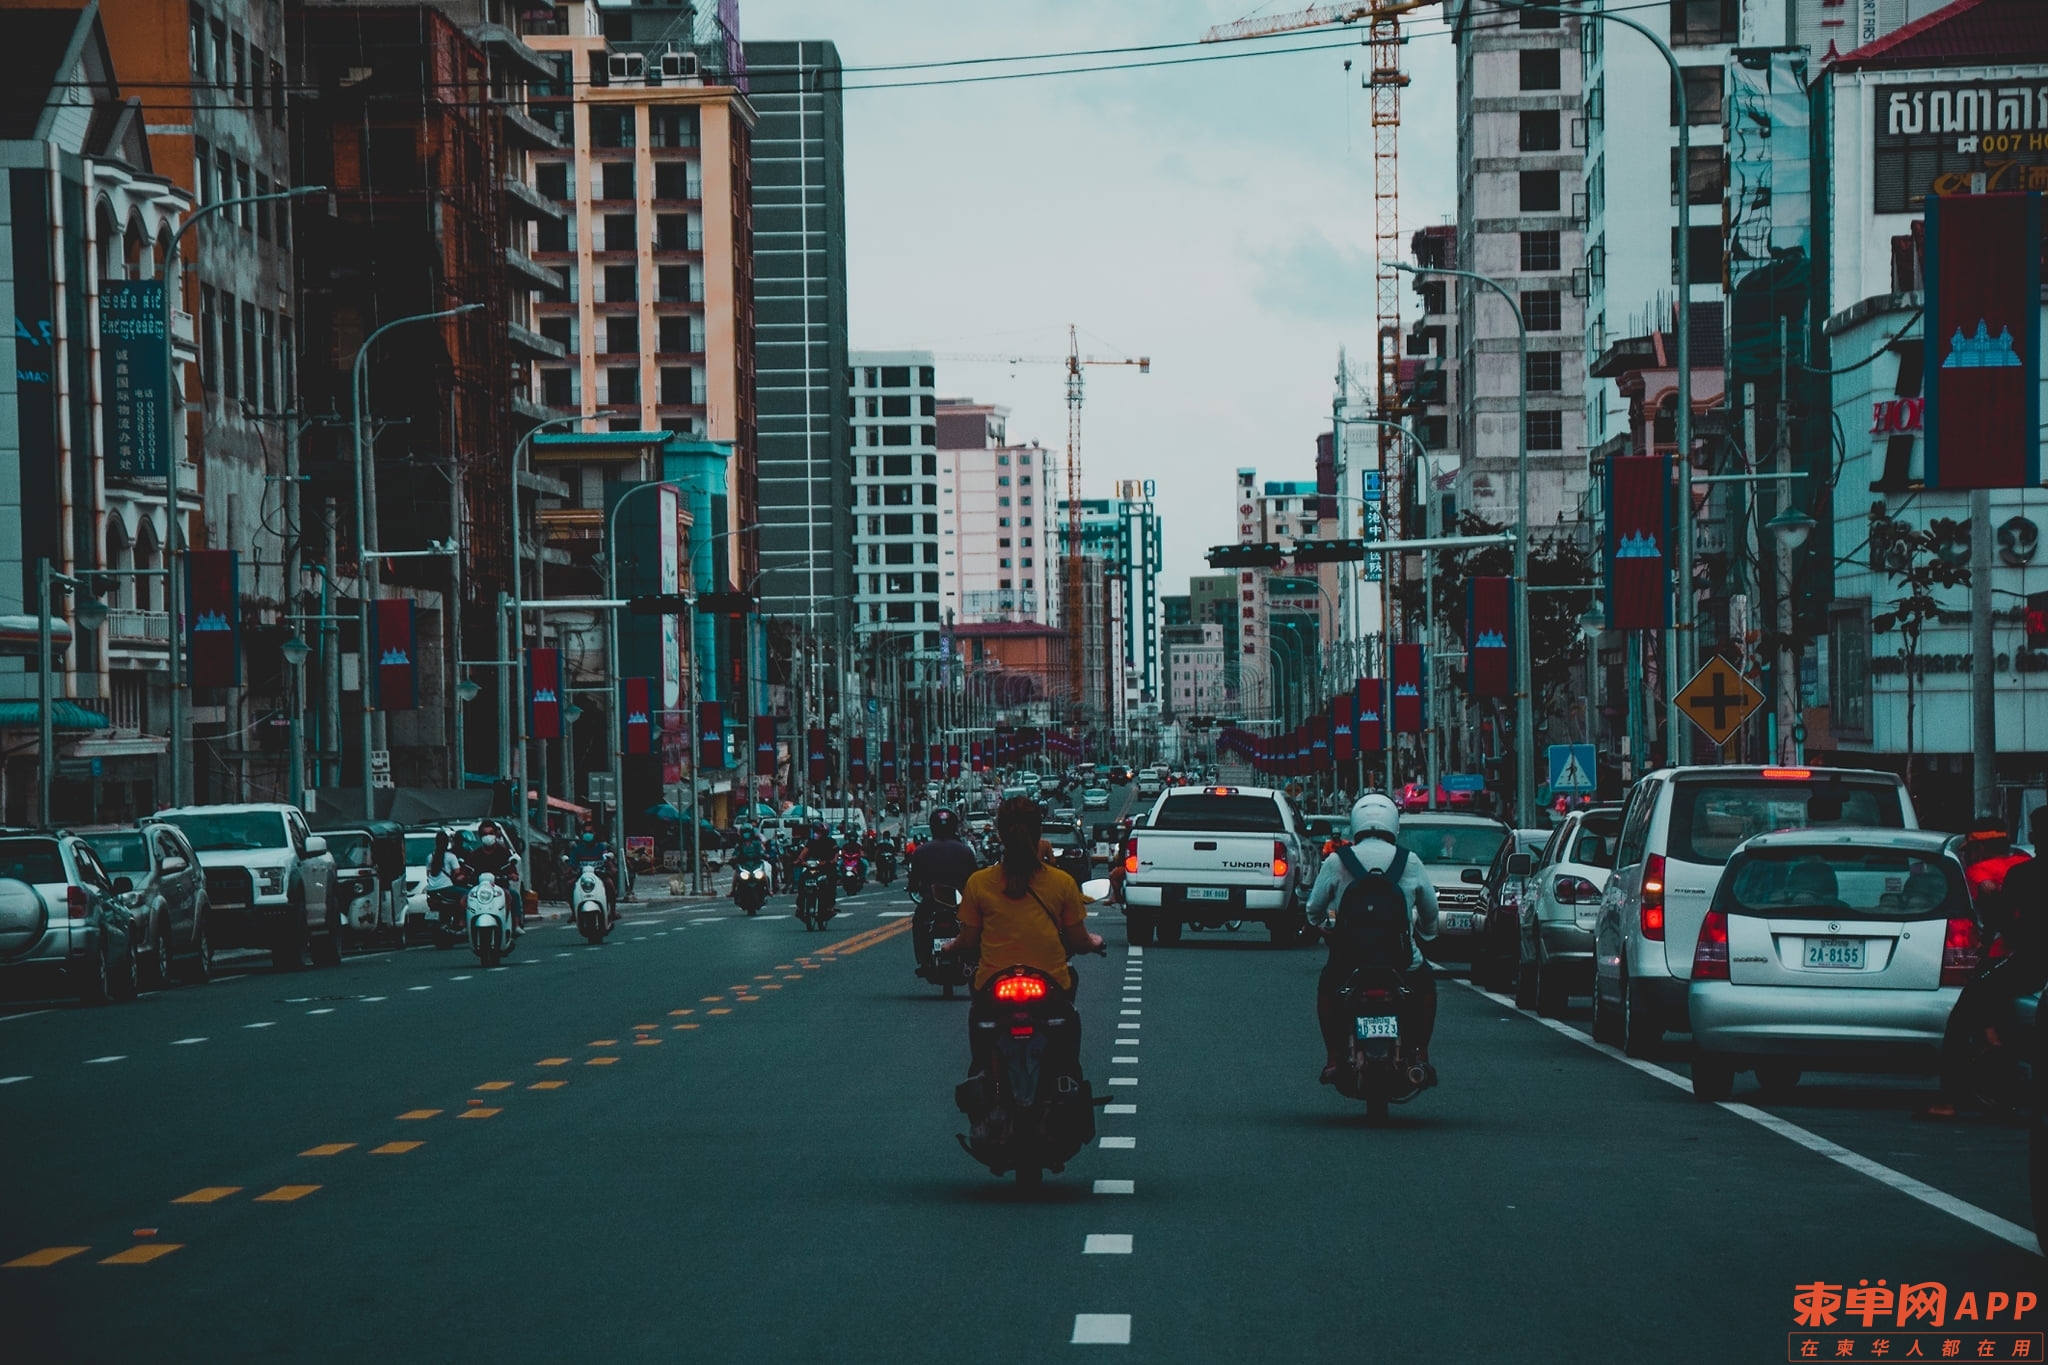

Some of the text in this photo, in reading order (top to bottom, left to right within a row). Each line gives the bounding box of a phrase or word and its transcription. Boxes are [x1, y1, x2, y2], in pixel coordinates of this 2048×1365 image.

[1863, 0, 1876, 16] RT
[1983, 133, 2023, 153] 007
[1810, 948, 1858, 963] 2A-8155
